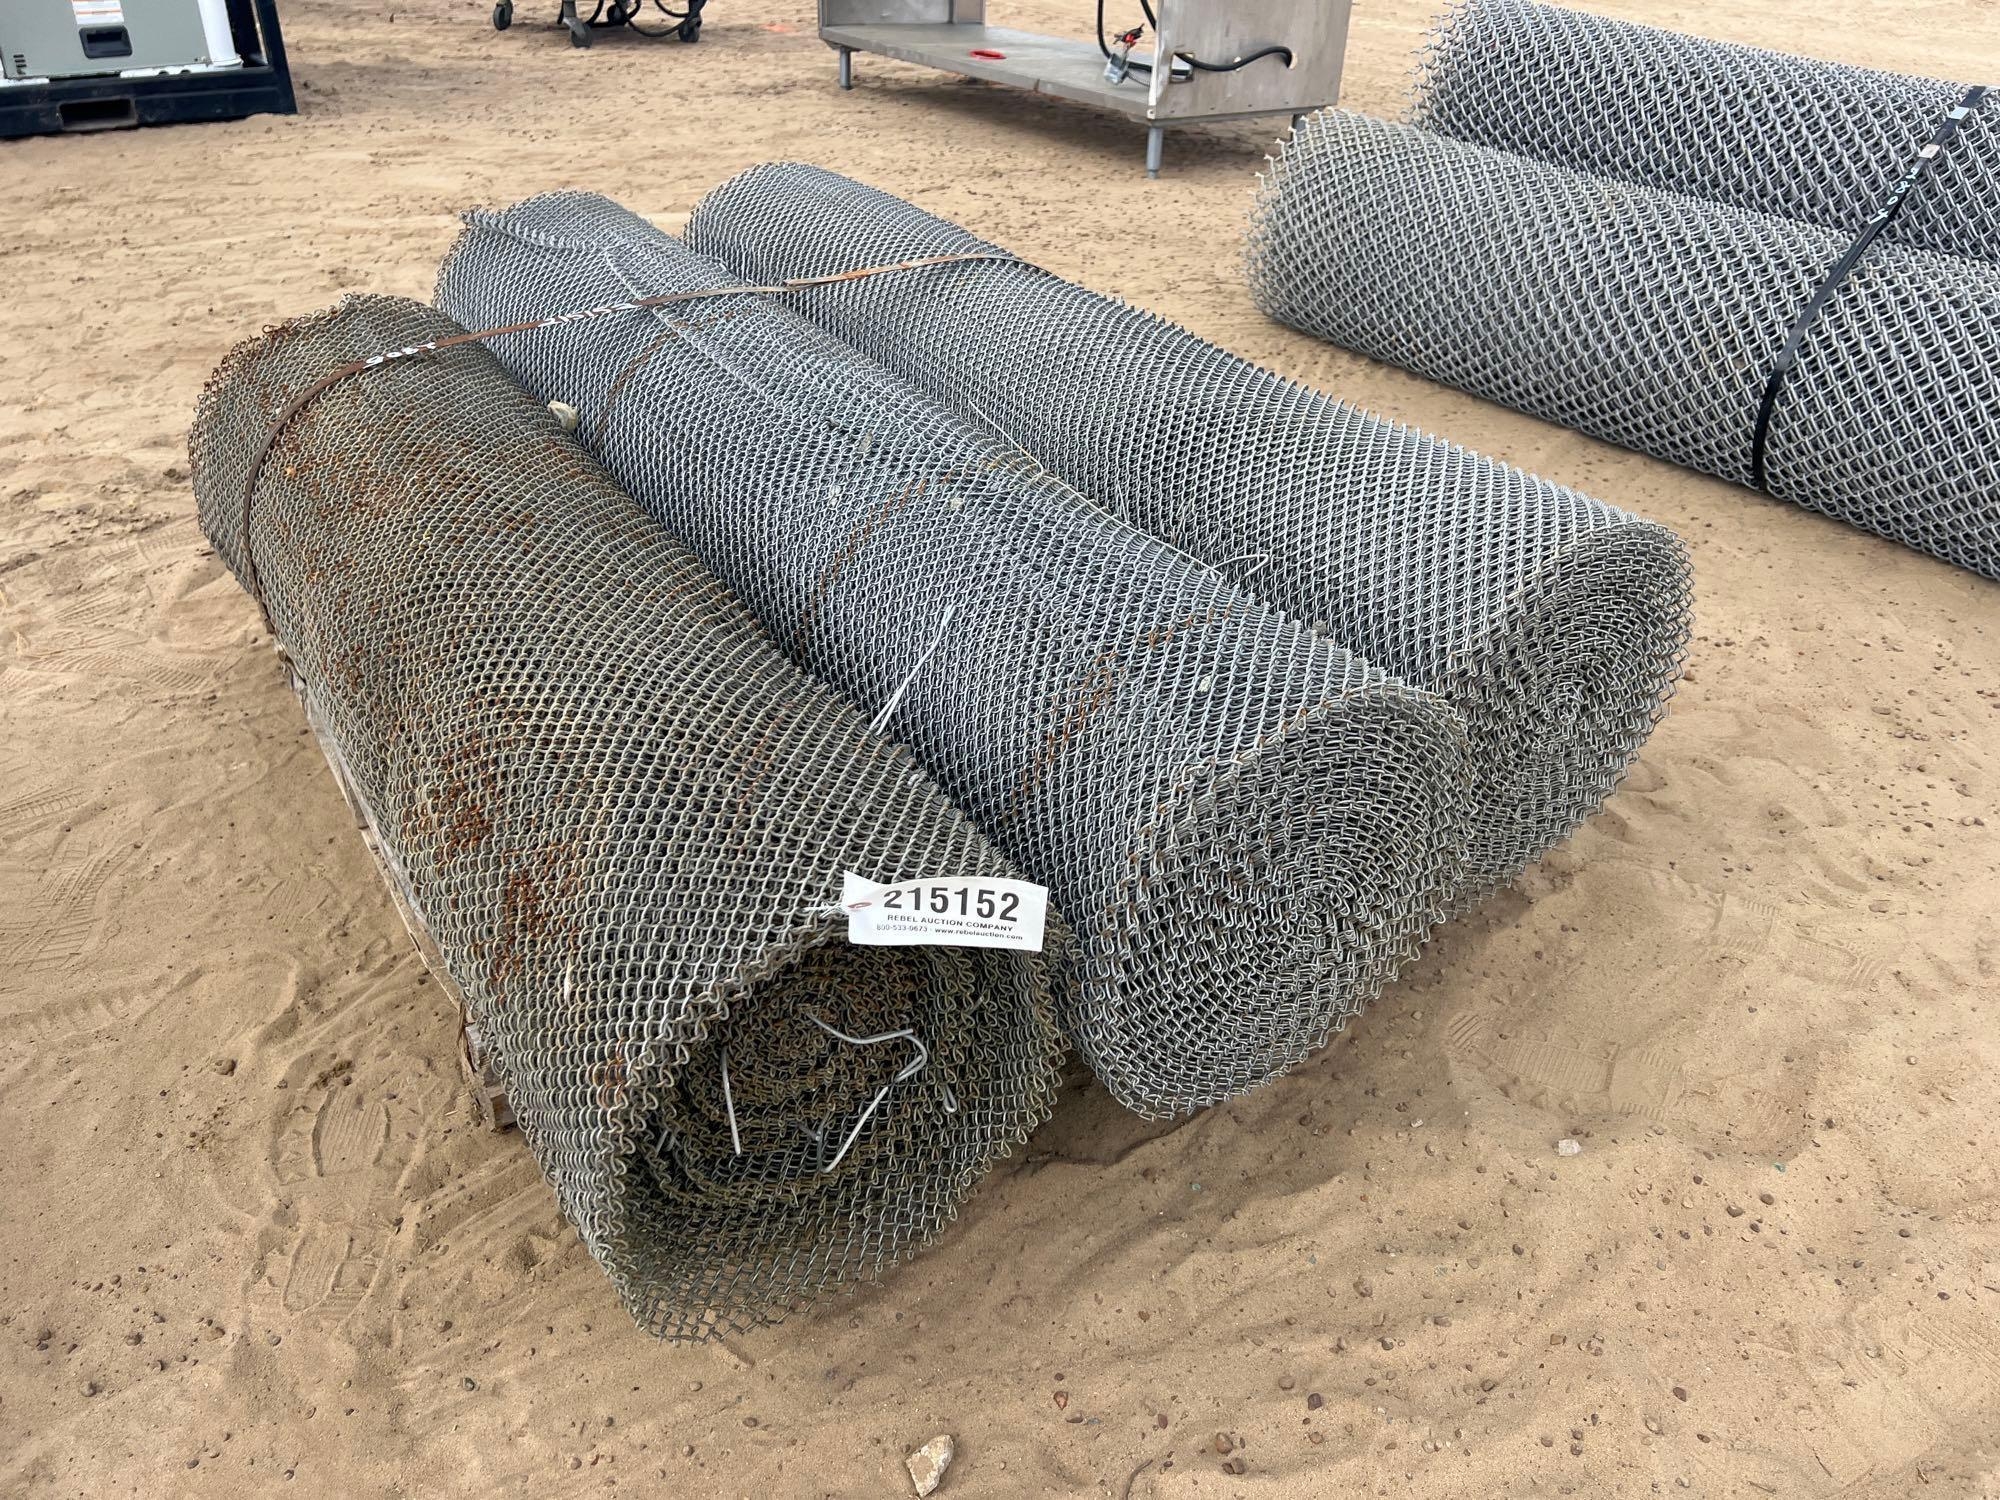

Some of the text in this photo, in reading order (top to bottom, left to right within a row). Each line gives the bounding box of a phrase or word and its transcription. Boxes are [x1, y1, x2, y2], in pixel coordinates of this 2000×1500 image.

[883, 886, 1020, 922] 215152
[887, 914, 1013, 932] REBEL AUCTION COMPANY
[934, 927, 1023, 940] www.rebelauction.com
